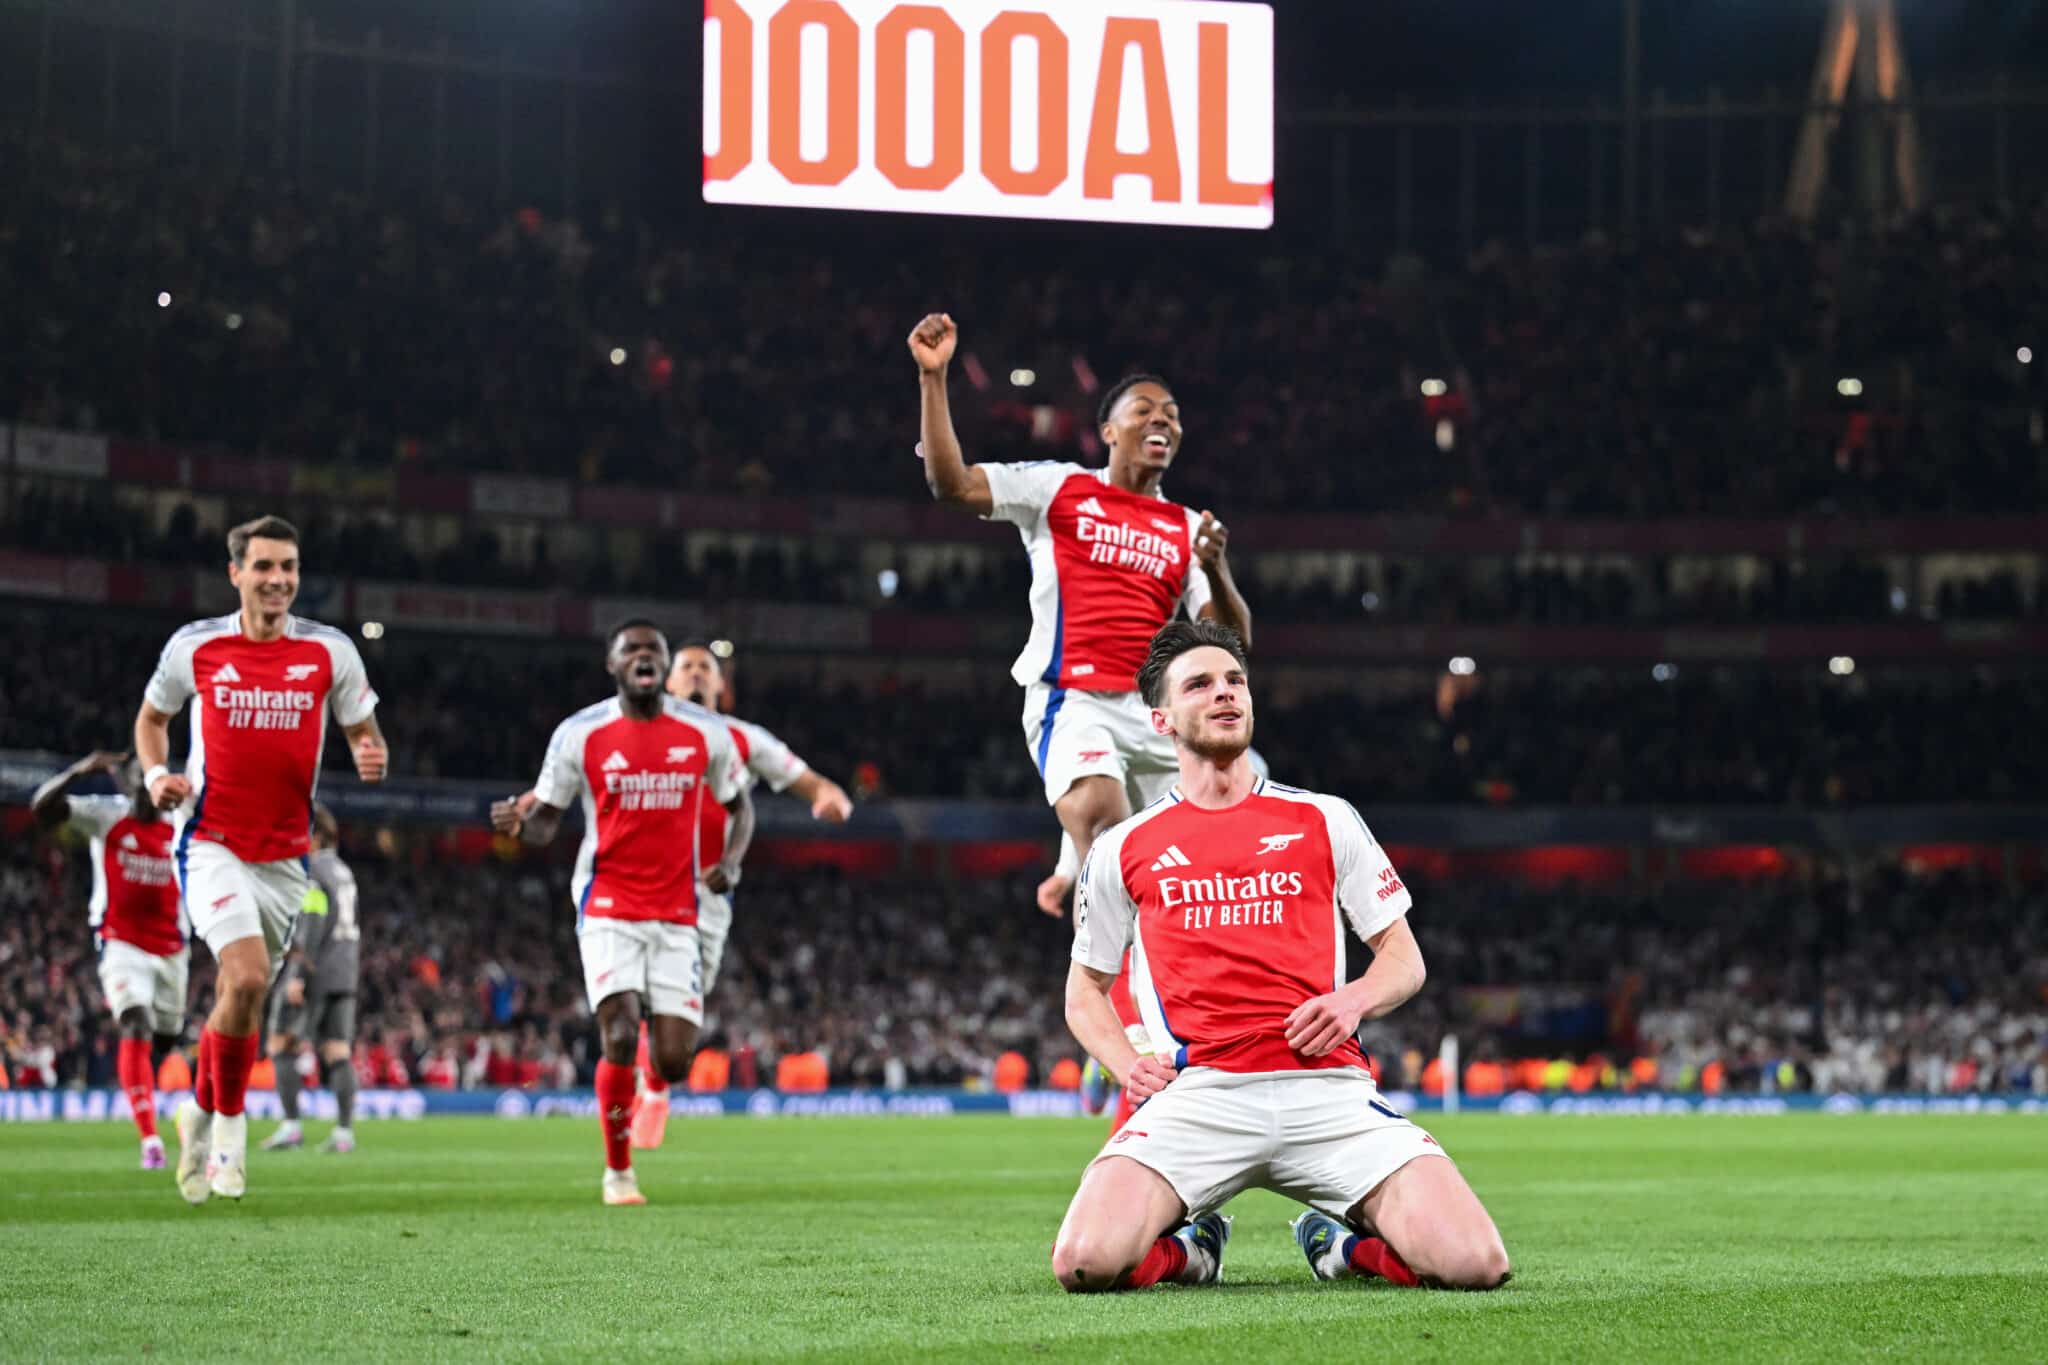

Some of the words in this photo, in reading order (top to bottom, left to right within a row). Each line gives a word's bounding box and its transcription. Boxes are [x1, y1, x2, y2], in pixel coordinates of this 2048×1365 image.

[1077, 516, 1180, 564] Emirates
[1089, 542, 1117, 564] FLY
[1118, 548, 1167, 579] BETTER
[214, 685, 315, 711] Emirates
[604, 769, 696, 795] Emirates
[1158, 868, 1303, 908] Emirates
[1183, 905, 1213, 930] FLY
[1219, 900, 1284, 926] BETTER
